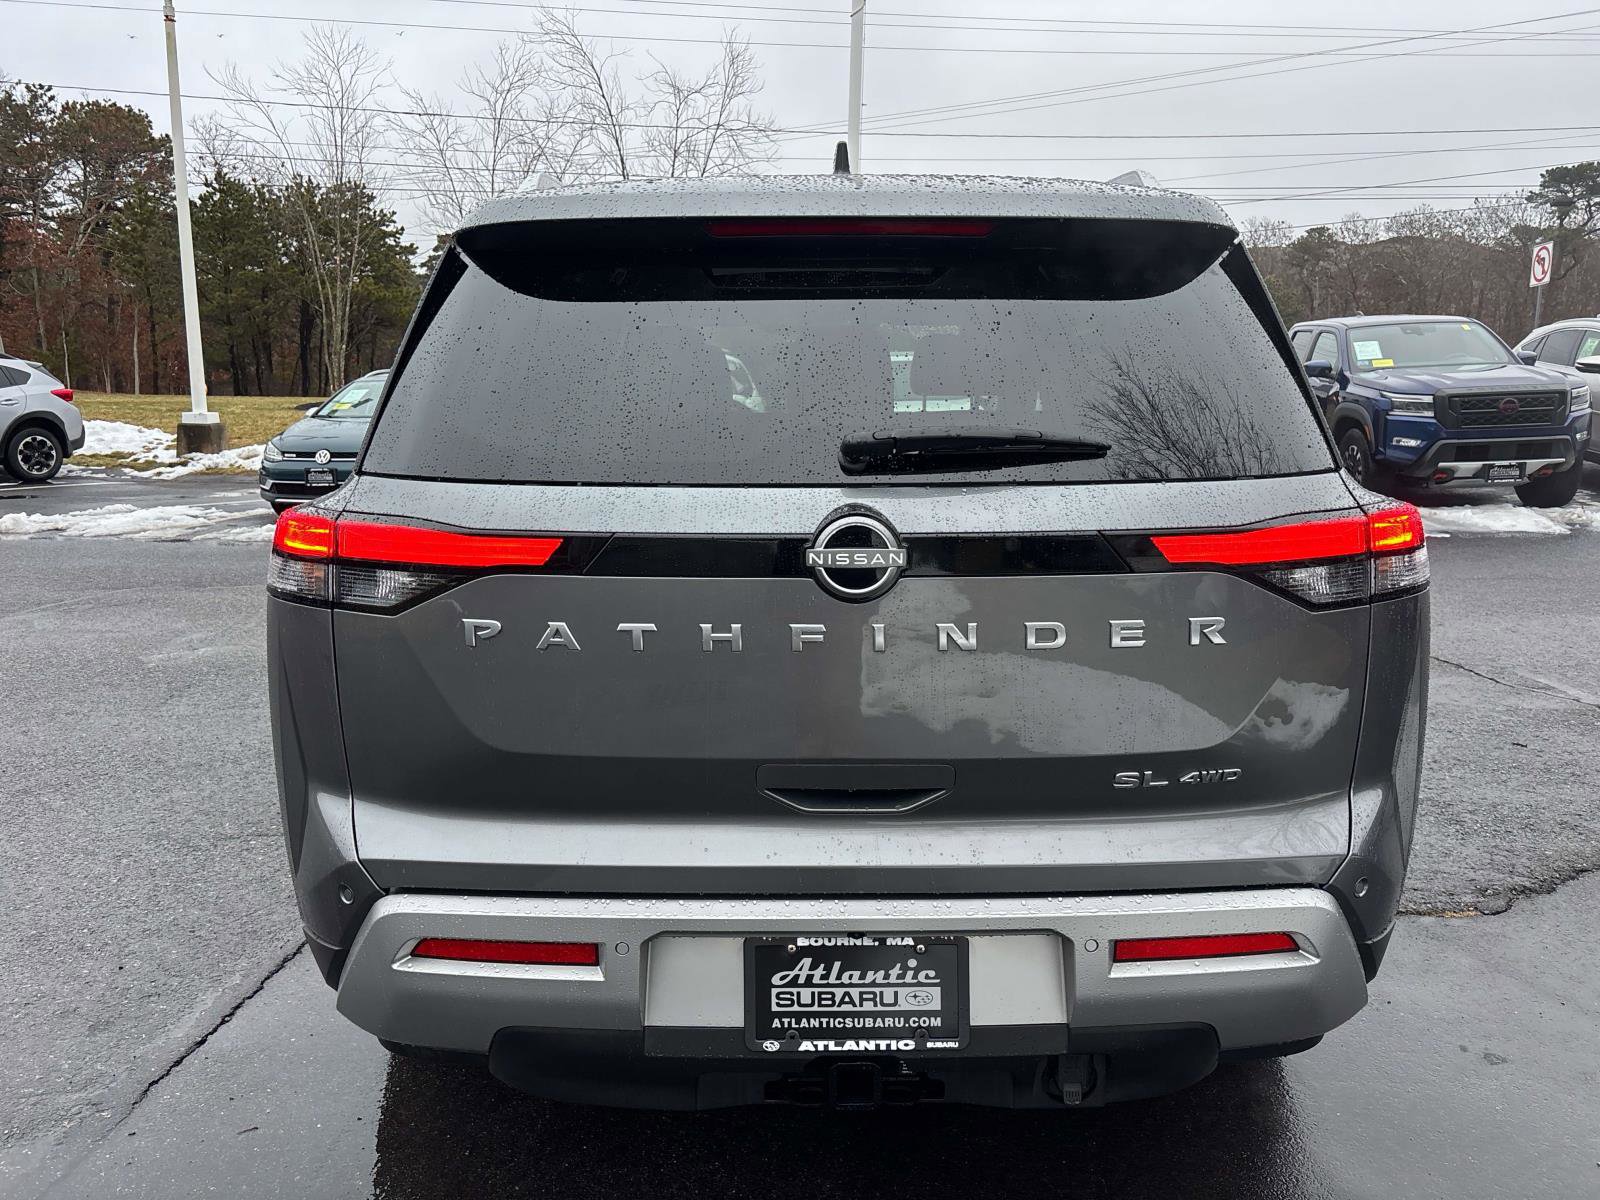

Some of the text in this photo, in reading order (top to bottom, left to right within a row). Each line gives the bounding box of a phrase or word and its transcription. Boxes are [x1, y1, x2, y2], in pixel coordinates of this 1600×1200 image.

[808, 552, 904, 565] NISSAN
[462, 616, 1227, 652] PATHFINDER
[1113, 769, 1241, 788] SL 4WD
[797, 937, 914, 946] BOURNE, MA
[771, 957, 941, 986] Atlantic
[775, 990, 899, 1008] SUBARU
[772, 1016, 942, 1028] ATLANTICSUBARU.COM
[798, 1039, 959, 1051] ATLANTIC SUBARU
